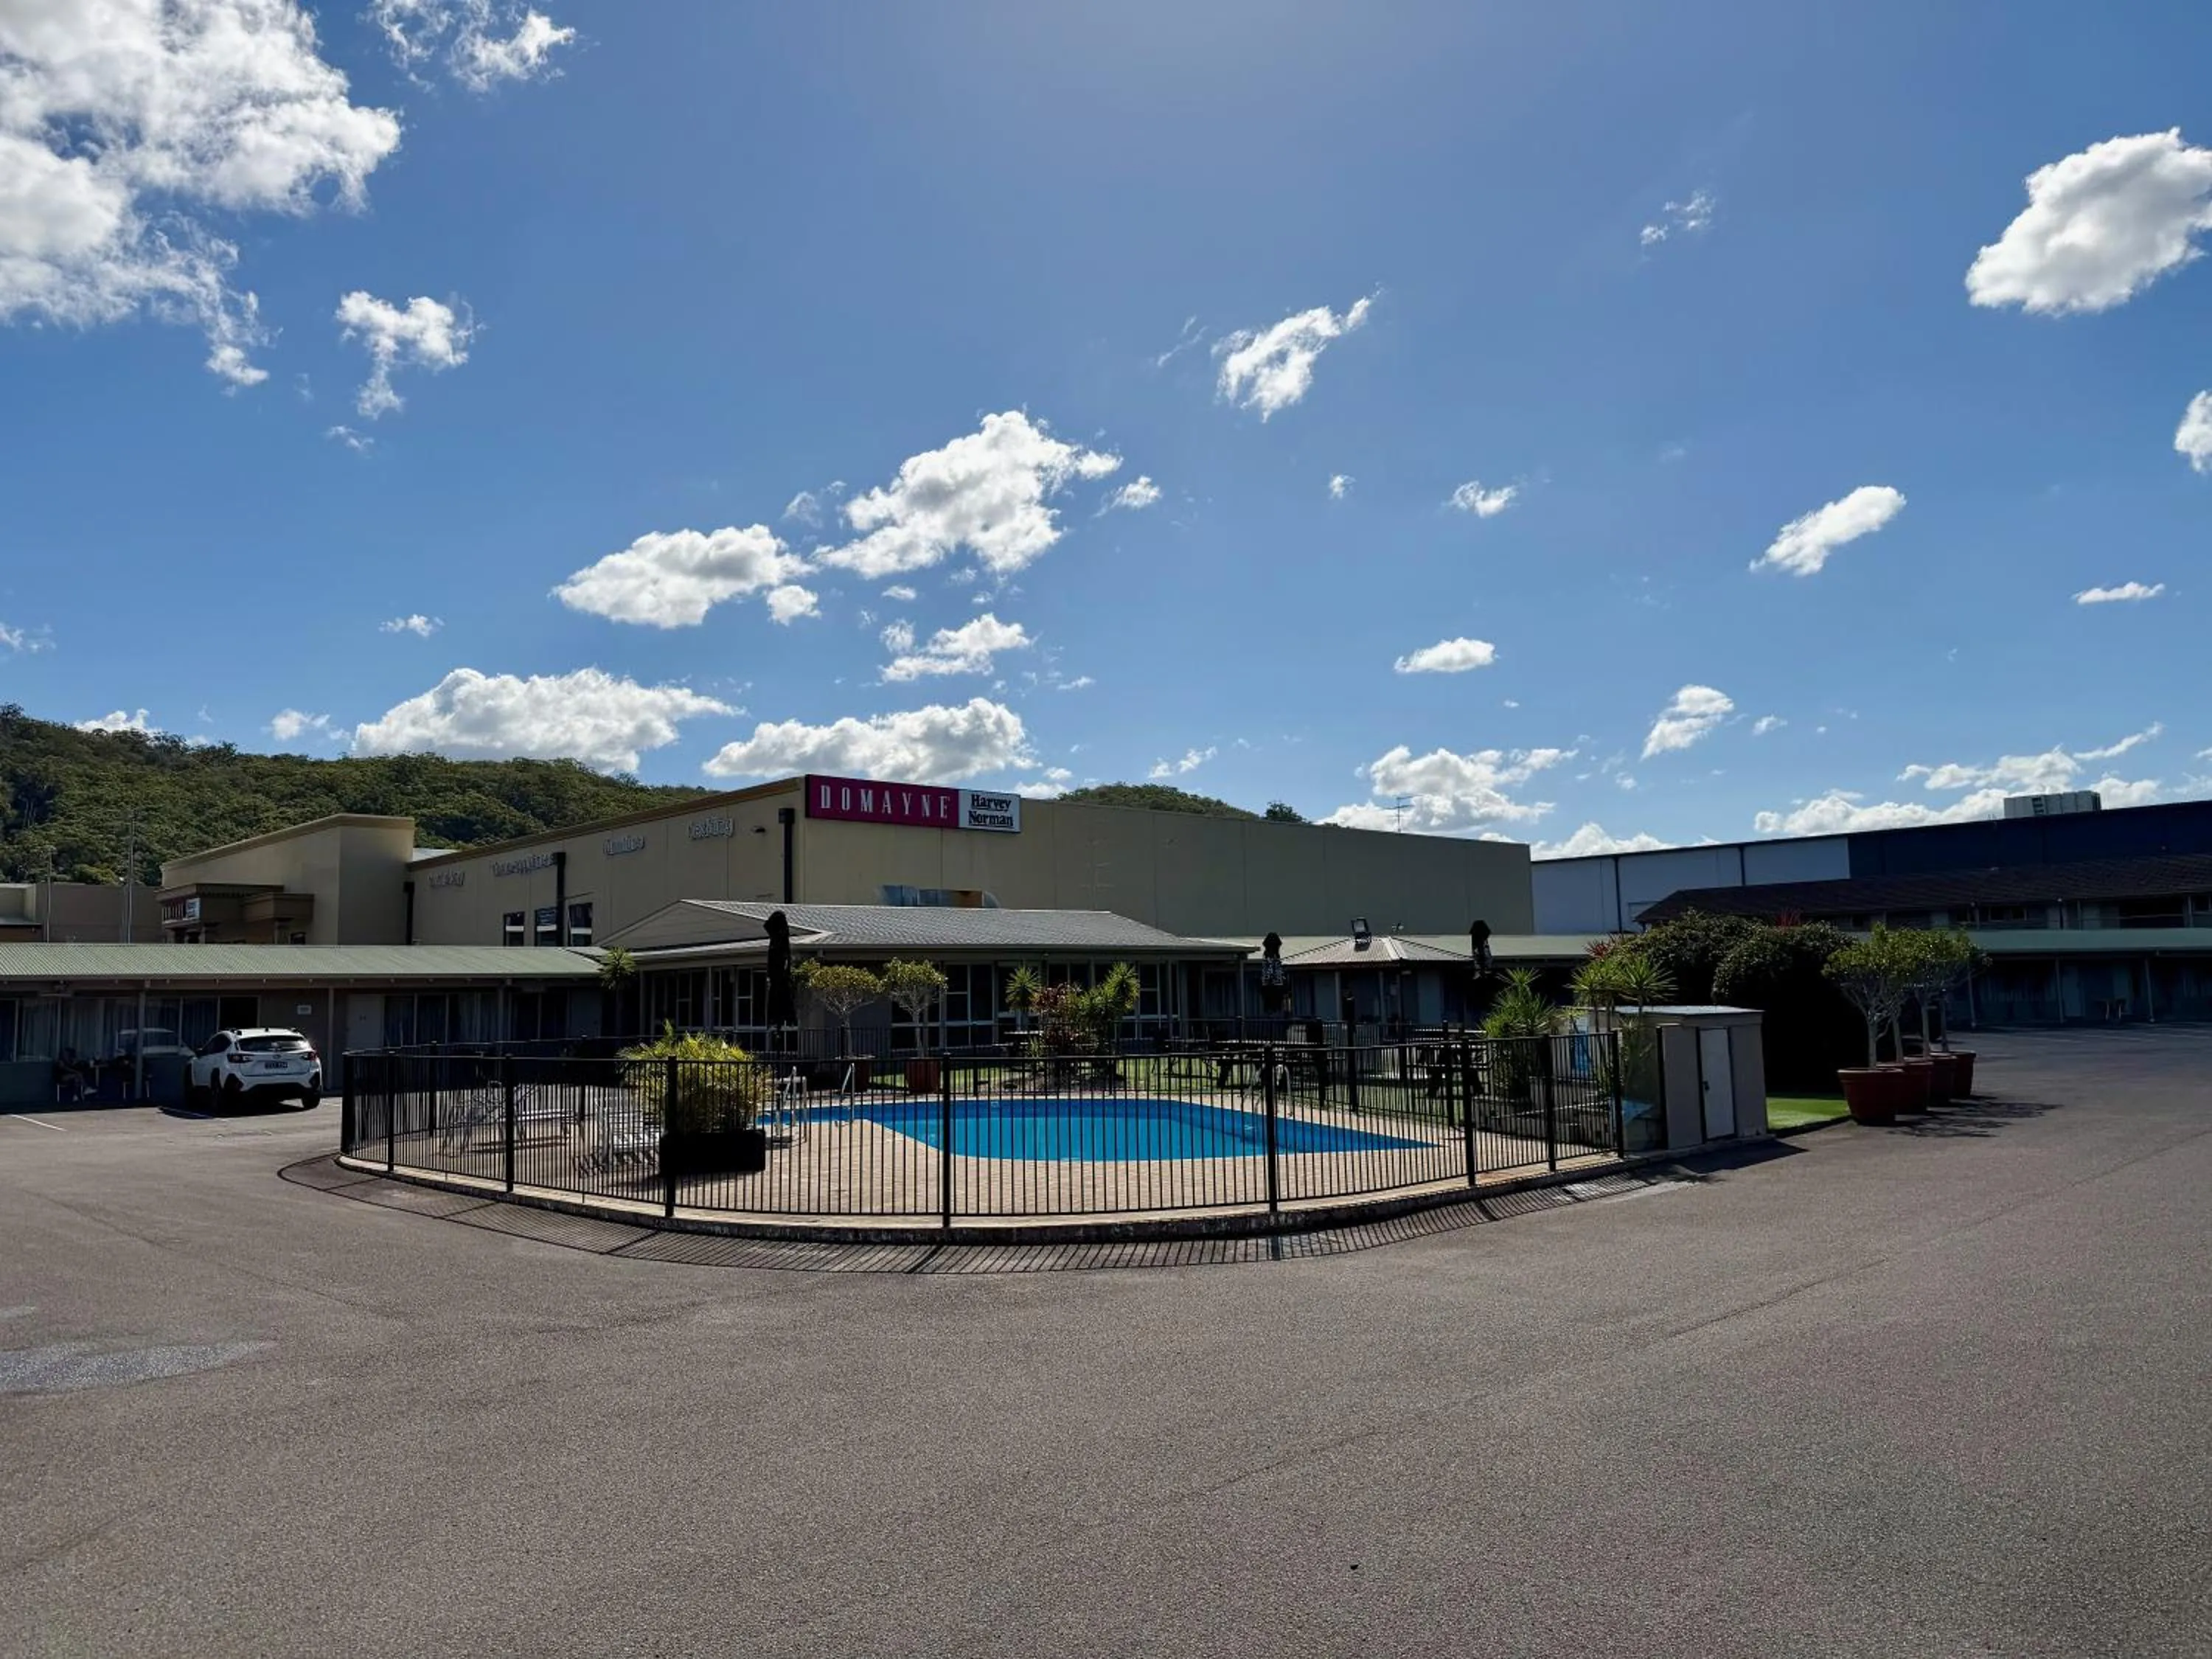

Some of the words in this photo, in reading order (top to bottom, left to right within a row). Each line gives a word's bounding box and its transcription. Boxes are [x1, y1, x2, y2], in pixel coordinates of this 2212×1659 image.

[821, 785, 950, 818] DOMAYNE
[971, 793, 1012, 812] Harvey
[968, 810, 1014, 827] Norman
